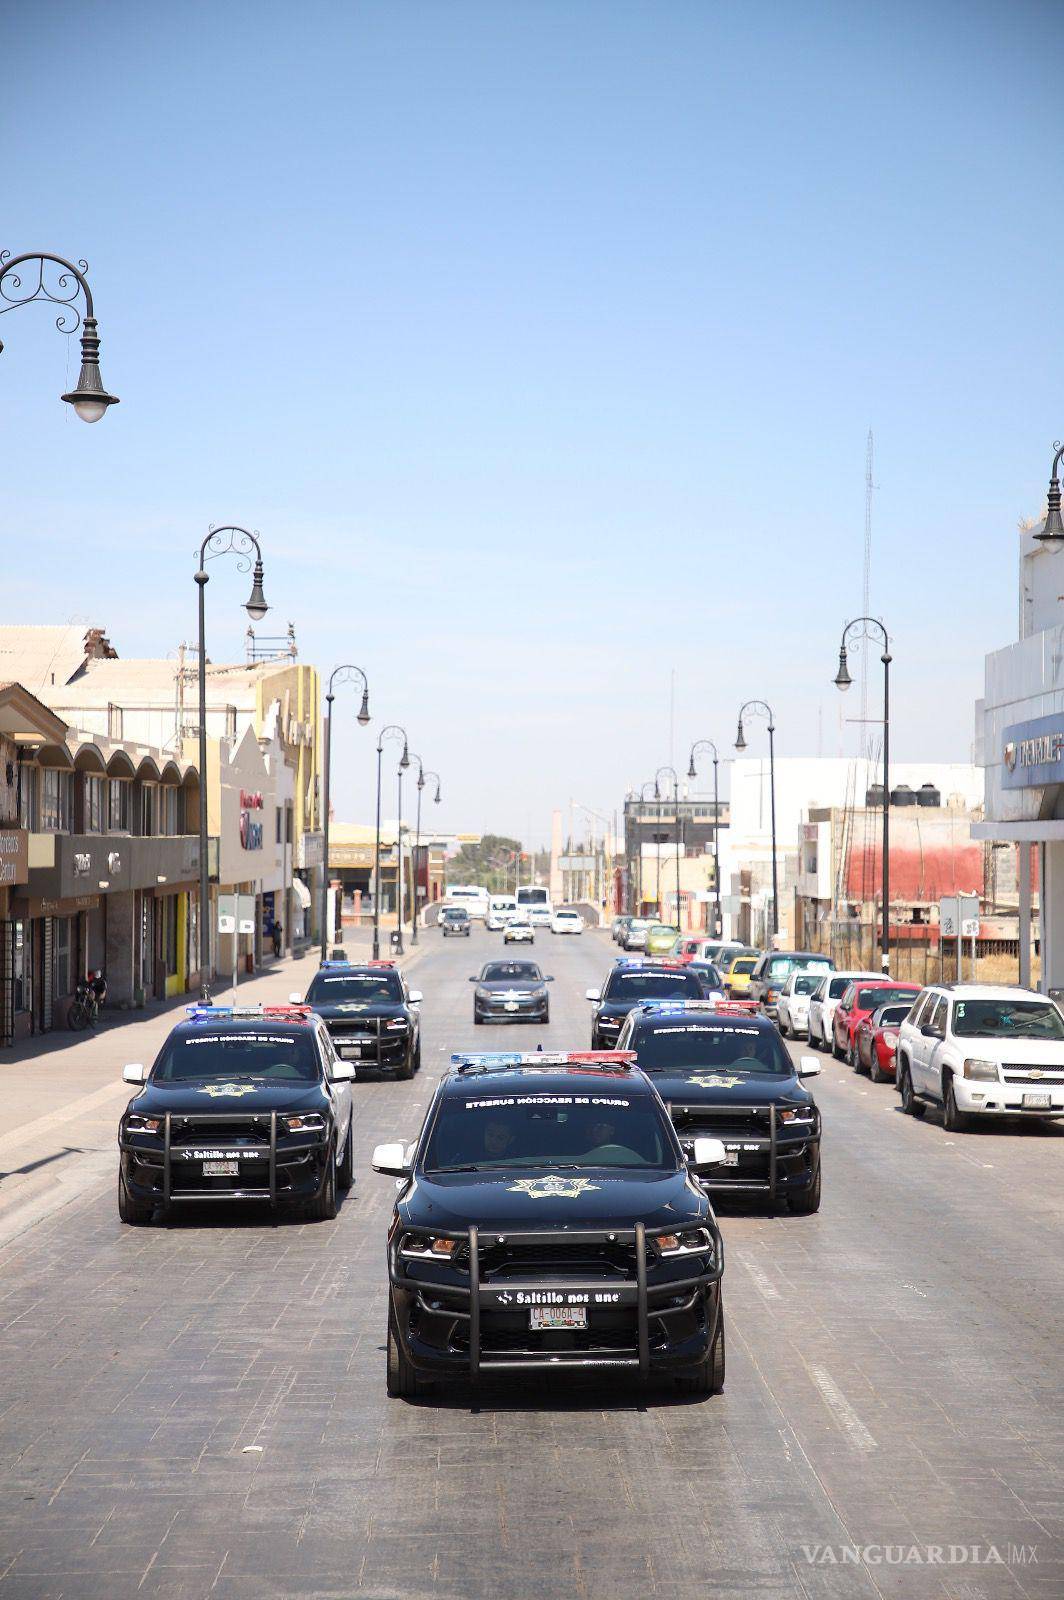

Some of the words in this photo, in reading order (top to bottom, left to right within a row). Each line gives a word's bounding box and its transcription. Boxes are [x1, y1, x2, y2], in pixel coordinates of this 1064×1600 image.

[516, 1291, 563, 1304] Saltillo
[567, 1293, 590, 1304] nos
[594, 1293, 619, 1303] une
